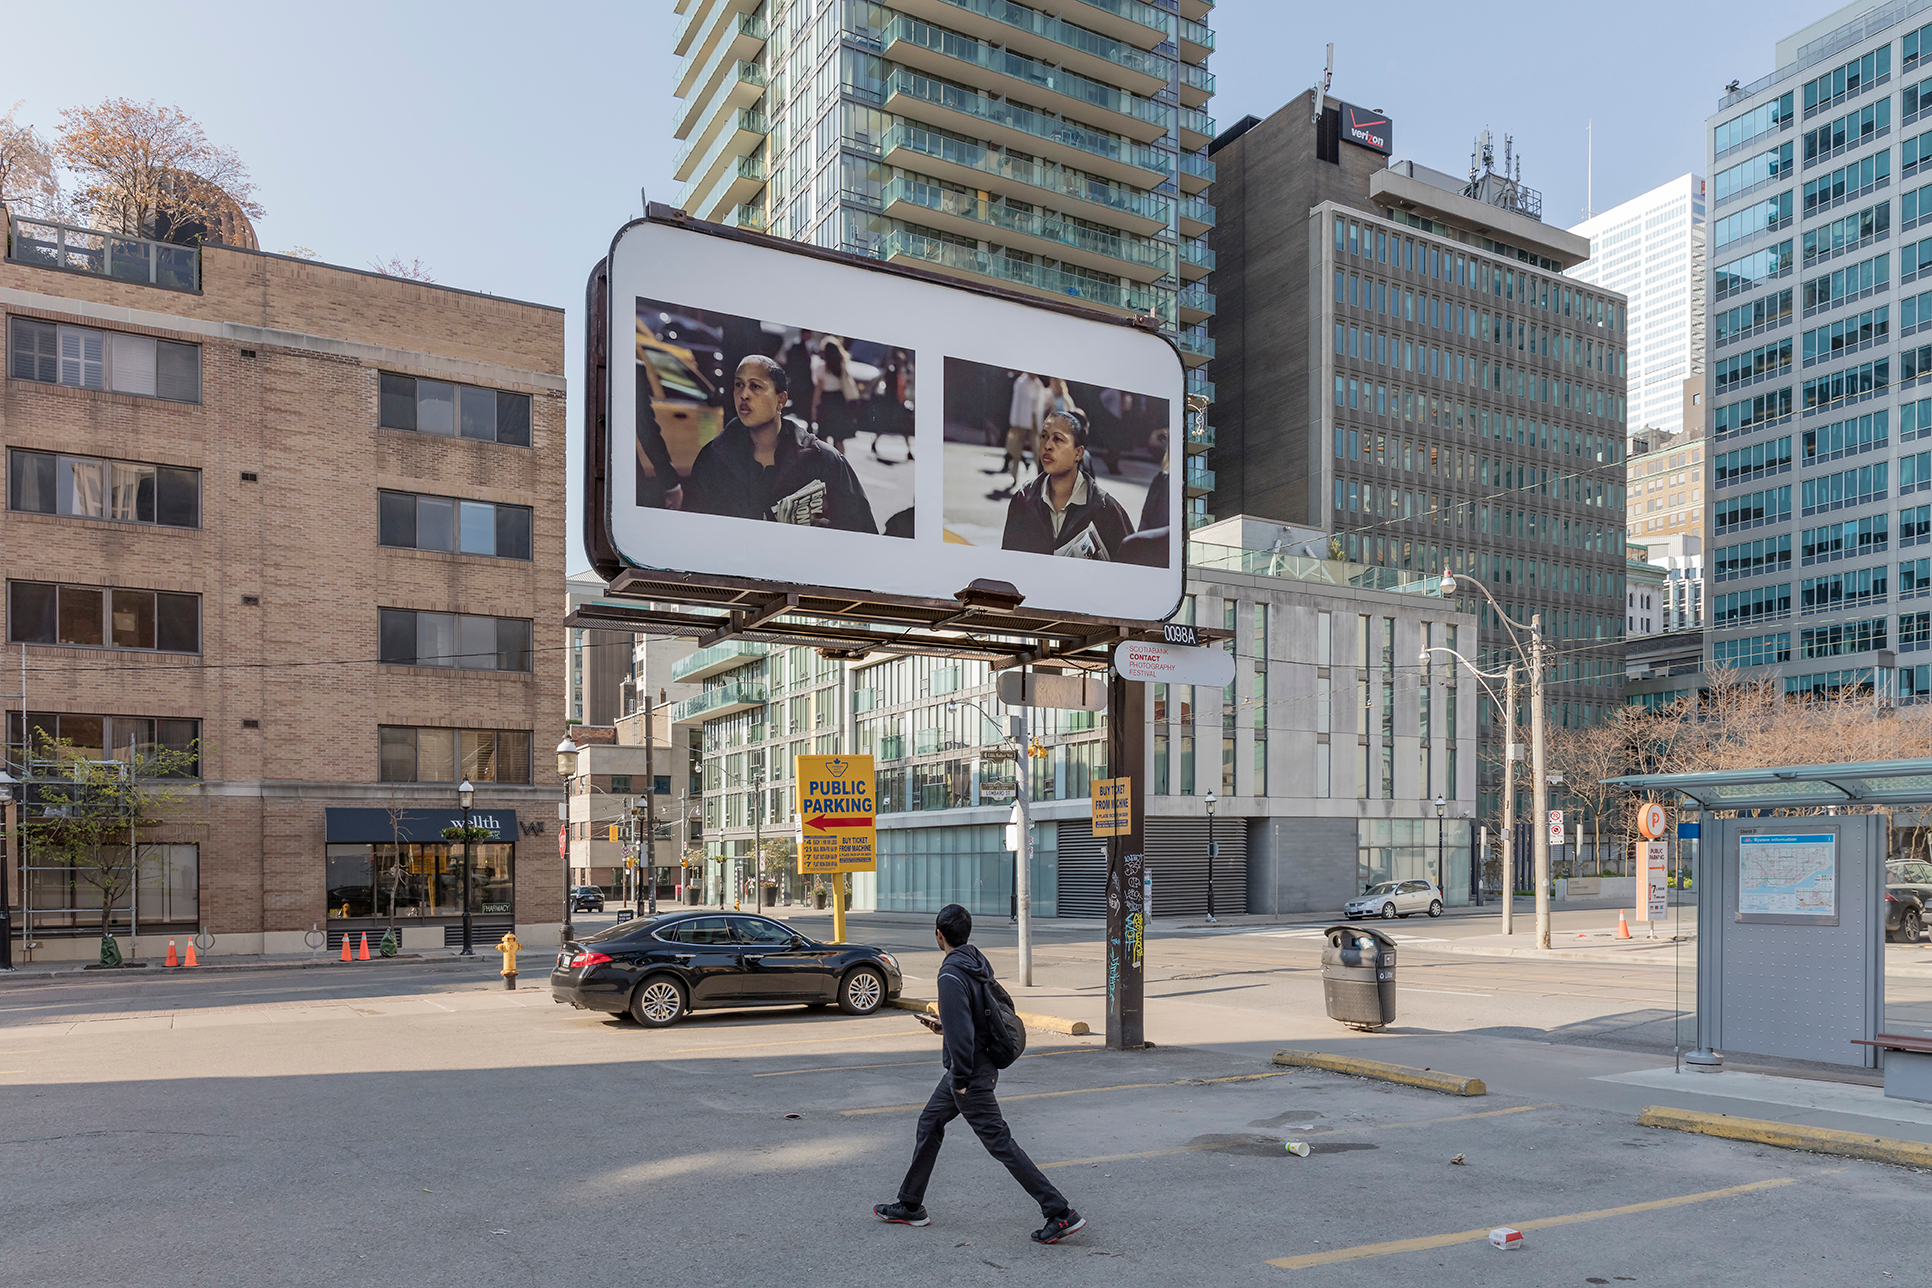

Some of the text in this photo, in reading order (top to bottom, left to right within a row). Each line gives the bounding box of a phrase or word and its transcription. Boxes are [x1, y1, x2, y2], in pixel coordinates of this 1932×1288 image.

[1351, 128, 1384, 148] verizon
[1164, 625, 1196, 645] 0098A
[1129, 645, 1169, 655] SCOTIABANK
[1129, 653, 1160, 662] CONTACT
[1129, 661, 1176, 671] PHOTOGRAPHY
[1129, 669, 1157, 678] FESTIVAL
[809, 780, 866, 796] PUBLIC
[1100, 785, 1110, 796] BUY
[804, 798, 872, 813] PARKING
[1095, 800, 1110, 810] FROM
[484, 904, 510, 912] PHARMACY
